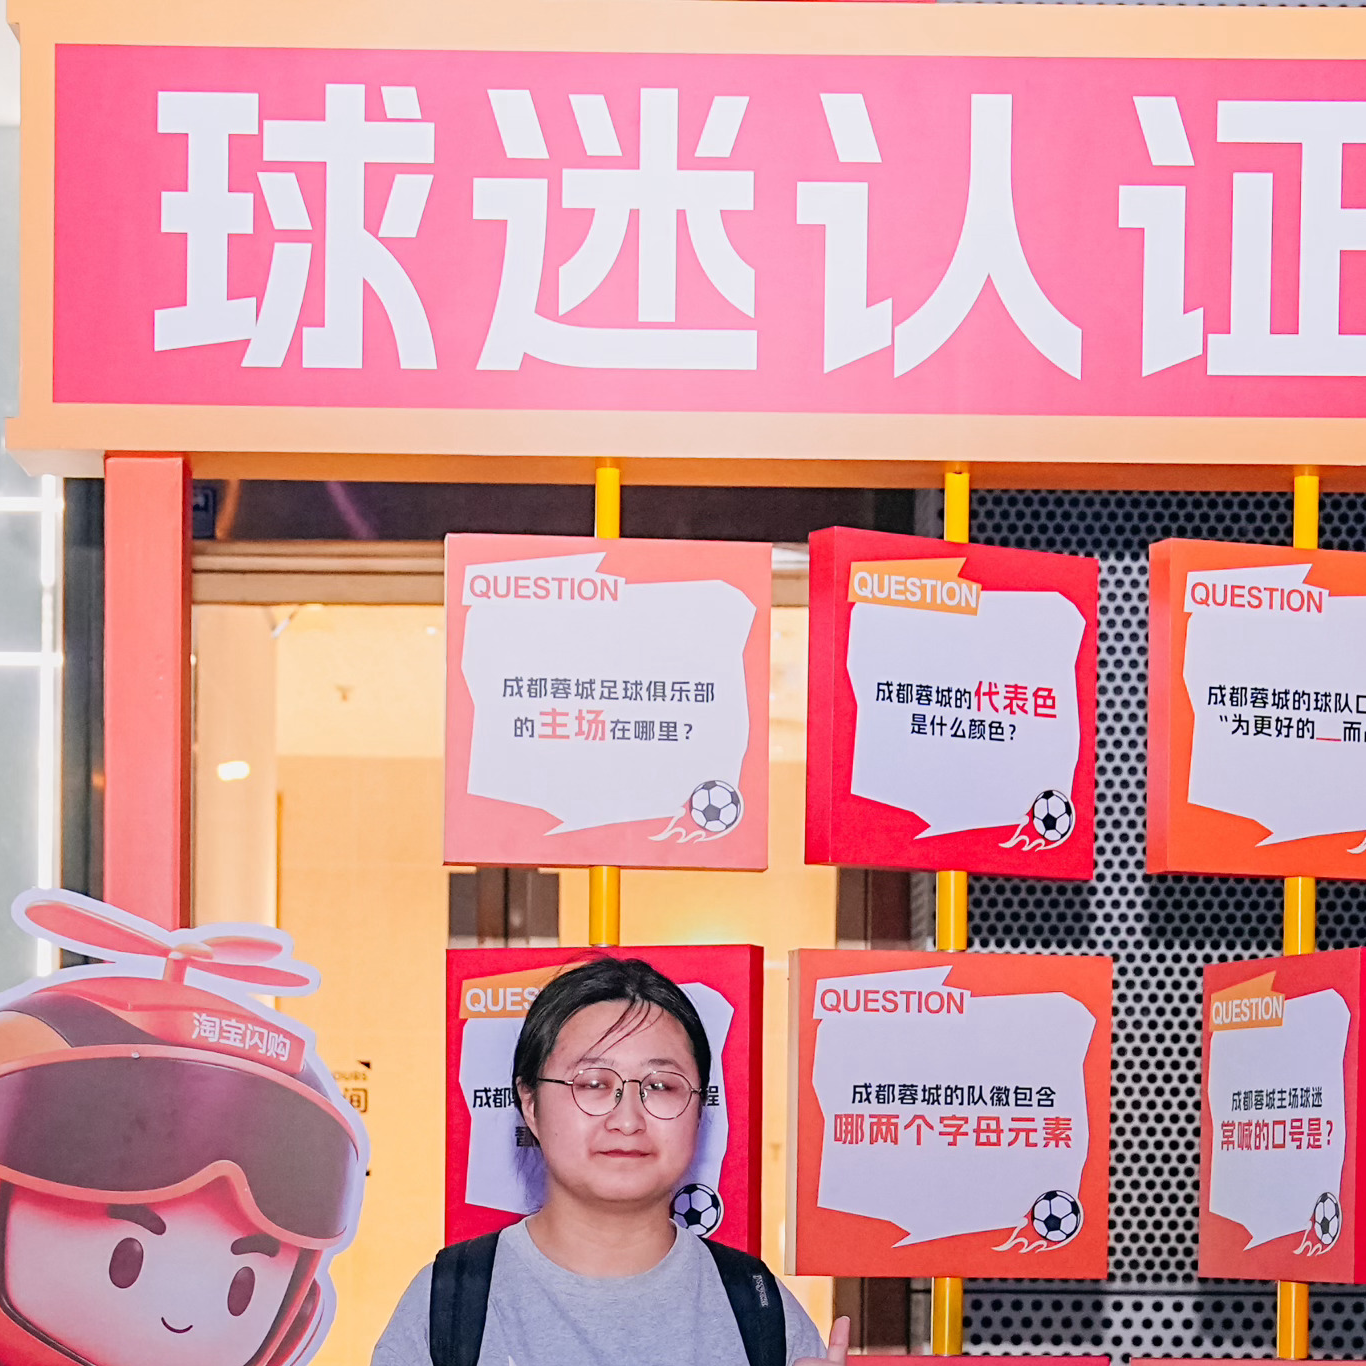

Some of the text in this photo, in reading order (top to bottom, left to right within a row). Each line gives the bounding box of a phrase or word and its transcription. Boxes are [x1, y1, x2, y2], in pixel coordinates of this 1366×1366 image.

[468, 573, 620, 602] QUESTION
[852, 570, 978, 609] QUESTION
[1190, 580, 1324, 613] QUESTION
[502, 675, 716, 704] 成都蓉城足球俱乐部
[875, 679, 1057, 720] 成都蓉城的代表色
[465, 986, 539, 1013] QUES
[819, 986, 965, 1016] QUESTION
[1212, 993, 1284, 1026] QUESTION
[191, 1012, 291, 1063] 淘宝闪购
[851, 1081, 1057, 1109] 成都蓉城的队徽包含
[1231, 1086, 1324, 1114] 成都蓉城主场球迷
[834, 1113, 1073, 1151] 哪两个字母元素
